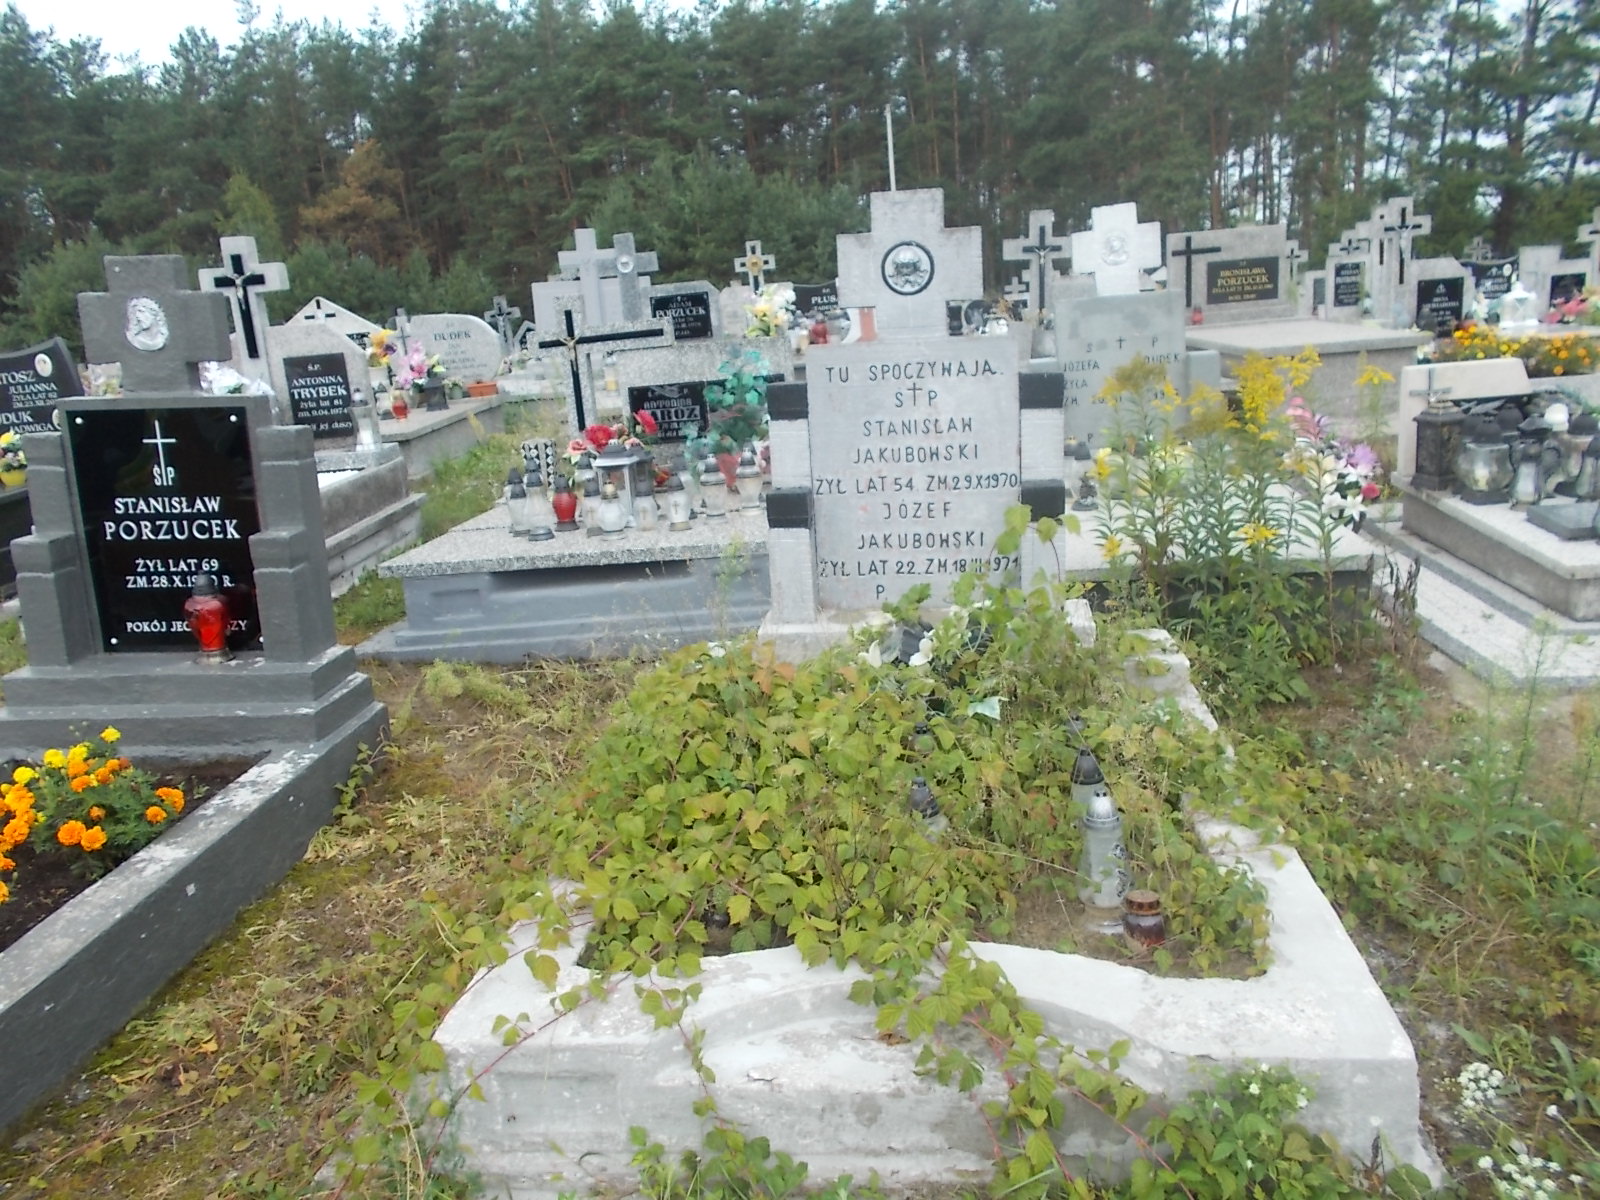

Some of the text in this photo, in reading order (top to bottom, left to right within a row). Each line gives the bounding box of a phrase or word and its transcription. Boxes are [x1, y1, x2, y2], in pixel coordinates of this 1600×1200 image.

[1217, 274, 1269, 287] PORZUCEK
[655, 306, 706, 318] PORZUCEK
[433, 330, 471, 341] DUDEK
[291, 375, 343, 387] ANTONINA
[825, 366, 849, 383] TU
[8, 382, 58, 395] JULIANNA
[291, 385, 347, 399] TRYBEK
[319, 399, 330, 407] lat
[863, 417, 973, 437] STANISŁAW
[853, 444, 978, 464] JAKUBOWSKI
[815, 475, 847, 496] ŻYŁ
[856, 476, 887, 494] LAT
[114, 496, 221, 514] STANISŁAW
[883, 499, 952, 520] JÓZEF
[104, 519, 241, 540] PORZUCEK
[857, 531, 984, 550] JAKUBOWSKI
[135, 557, 219, 572] ŻYŁ LAT 69
[857, 558, 888, 577] LAT
[222, 575, 235, 587] R.
[126, 619, 167, 632] POKÓJ
